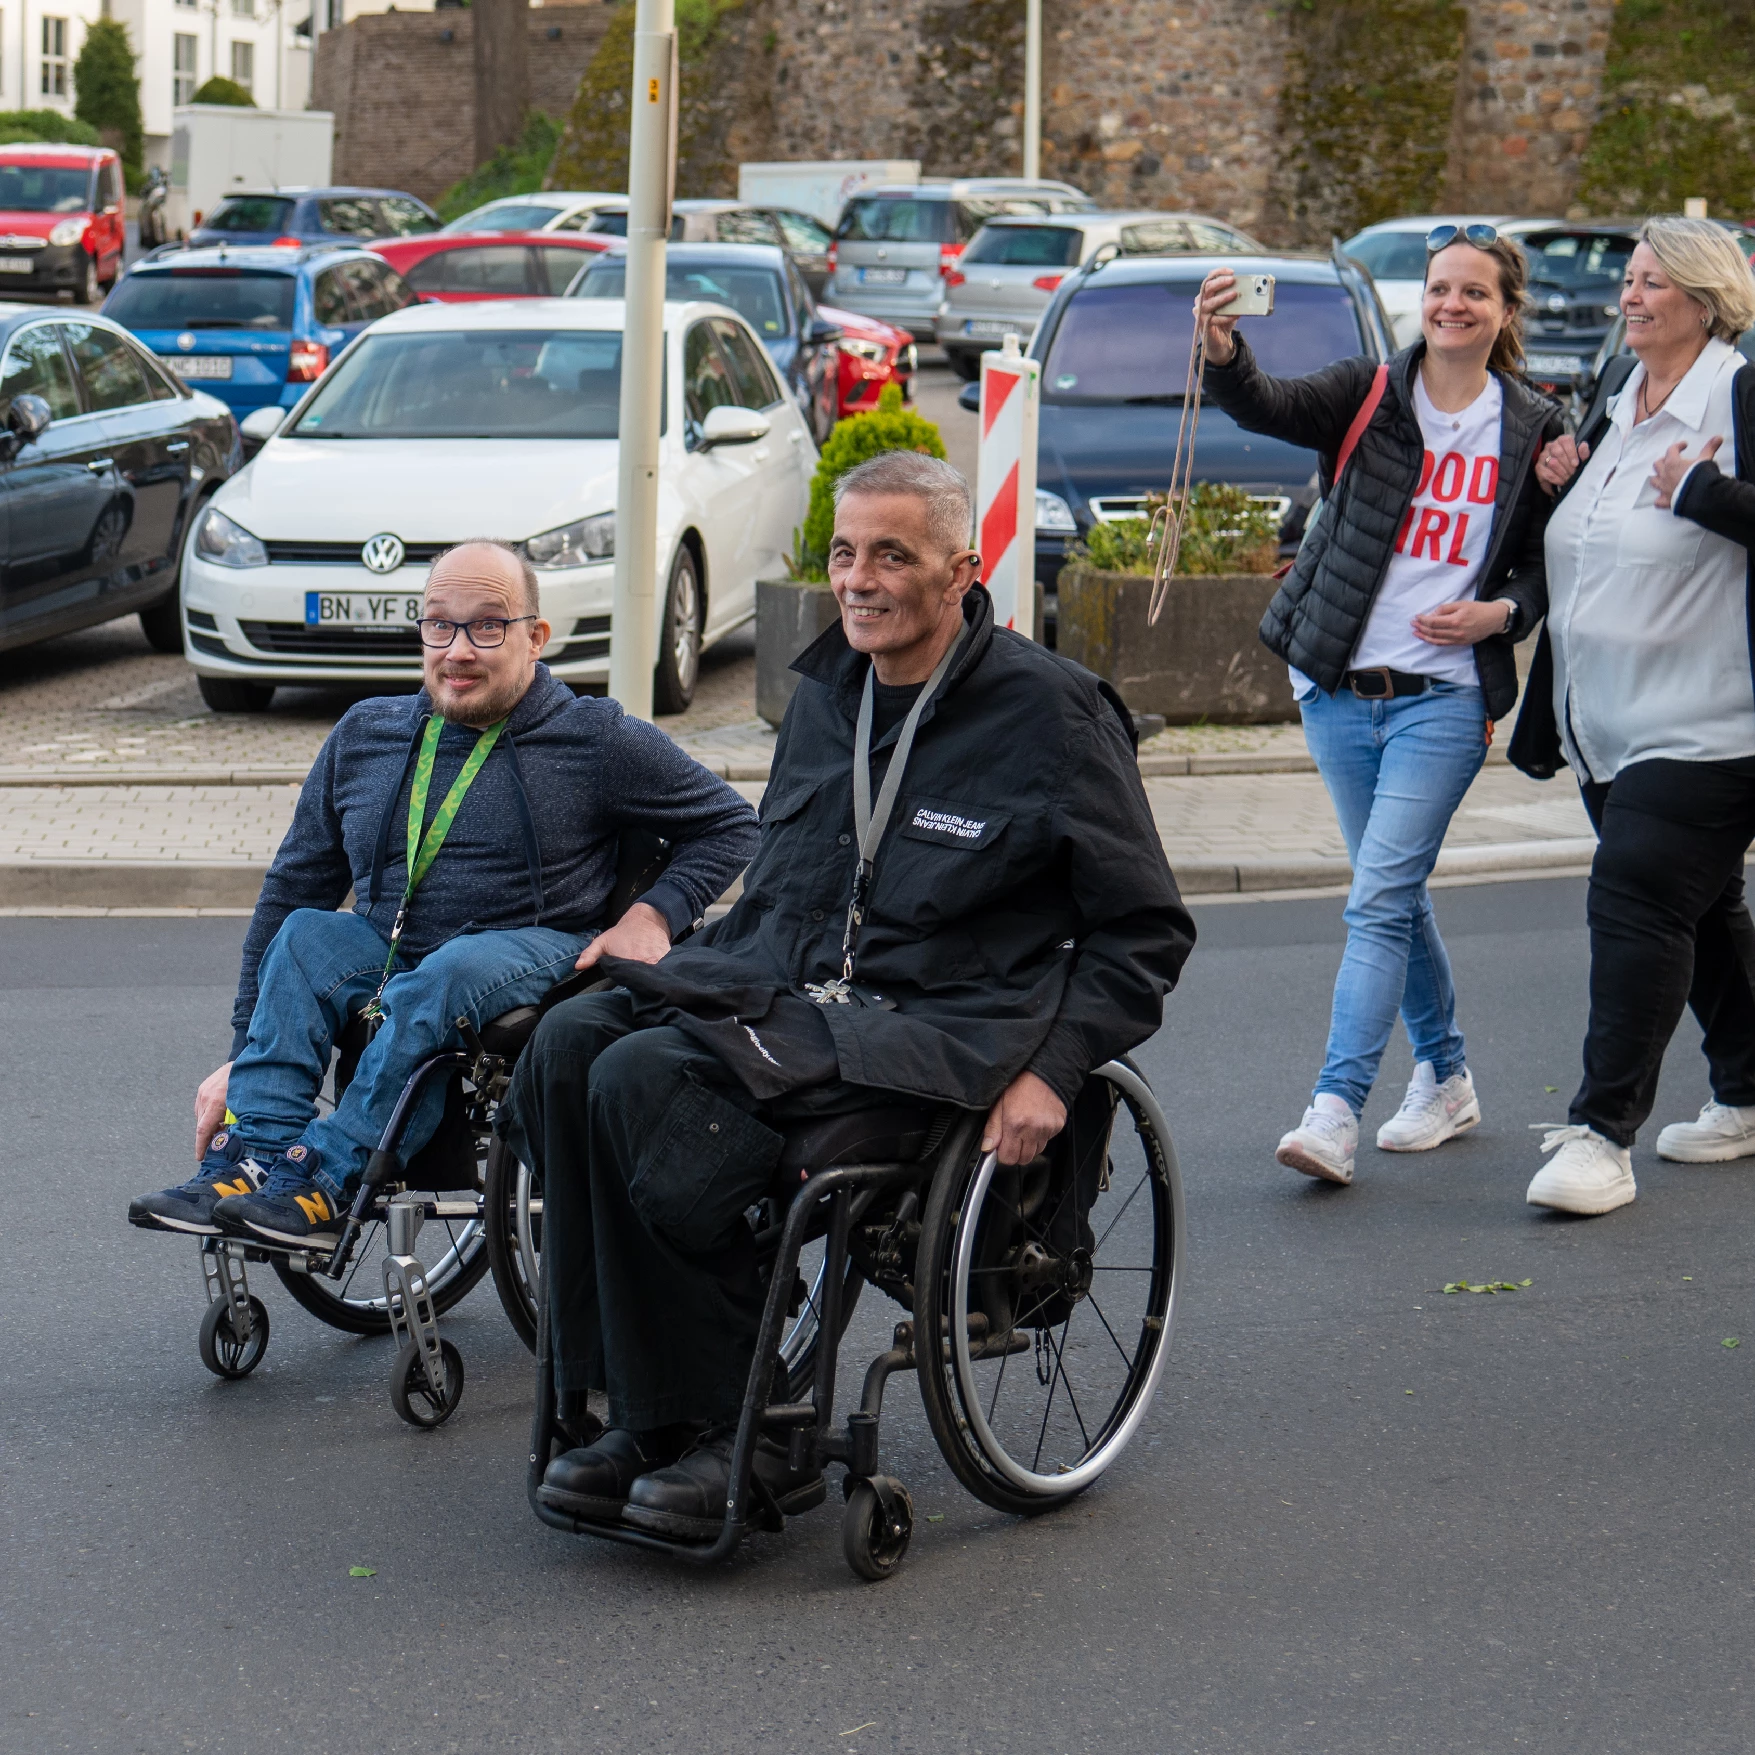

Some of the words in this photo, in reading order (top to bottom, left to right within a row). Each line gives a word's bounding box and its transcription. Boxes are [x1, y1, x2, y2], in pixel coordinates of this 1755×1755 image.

[1394, 506, 1470, 567] IRL
[363, 533, 404, 573] VW
[320, 597, 350, 620] BN
[367, 597, 398, 620] YF
[405, 598, 419, 621] 8
[912, 816, 937, 830] JEANS
[916, 808, 943, 822] CALVIN
[941, 813, 965, 827] KLEIN
[963, 820, 987, 830] JEANS
[211, 1178, 252, 1199] N
[294, 1191, 331, 1225] N
